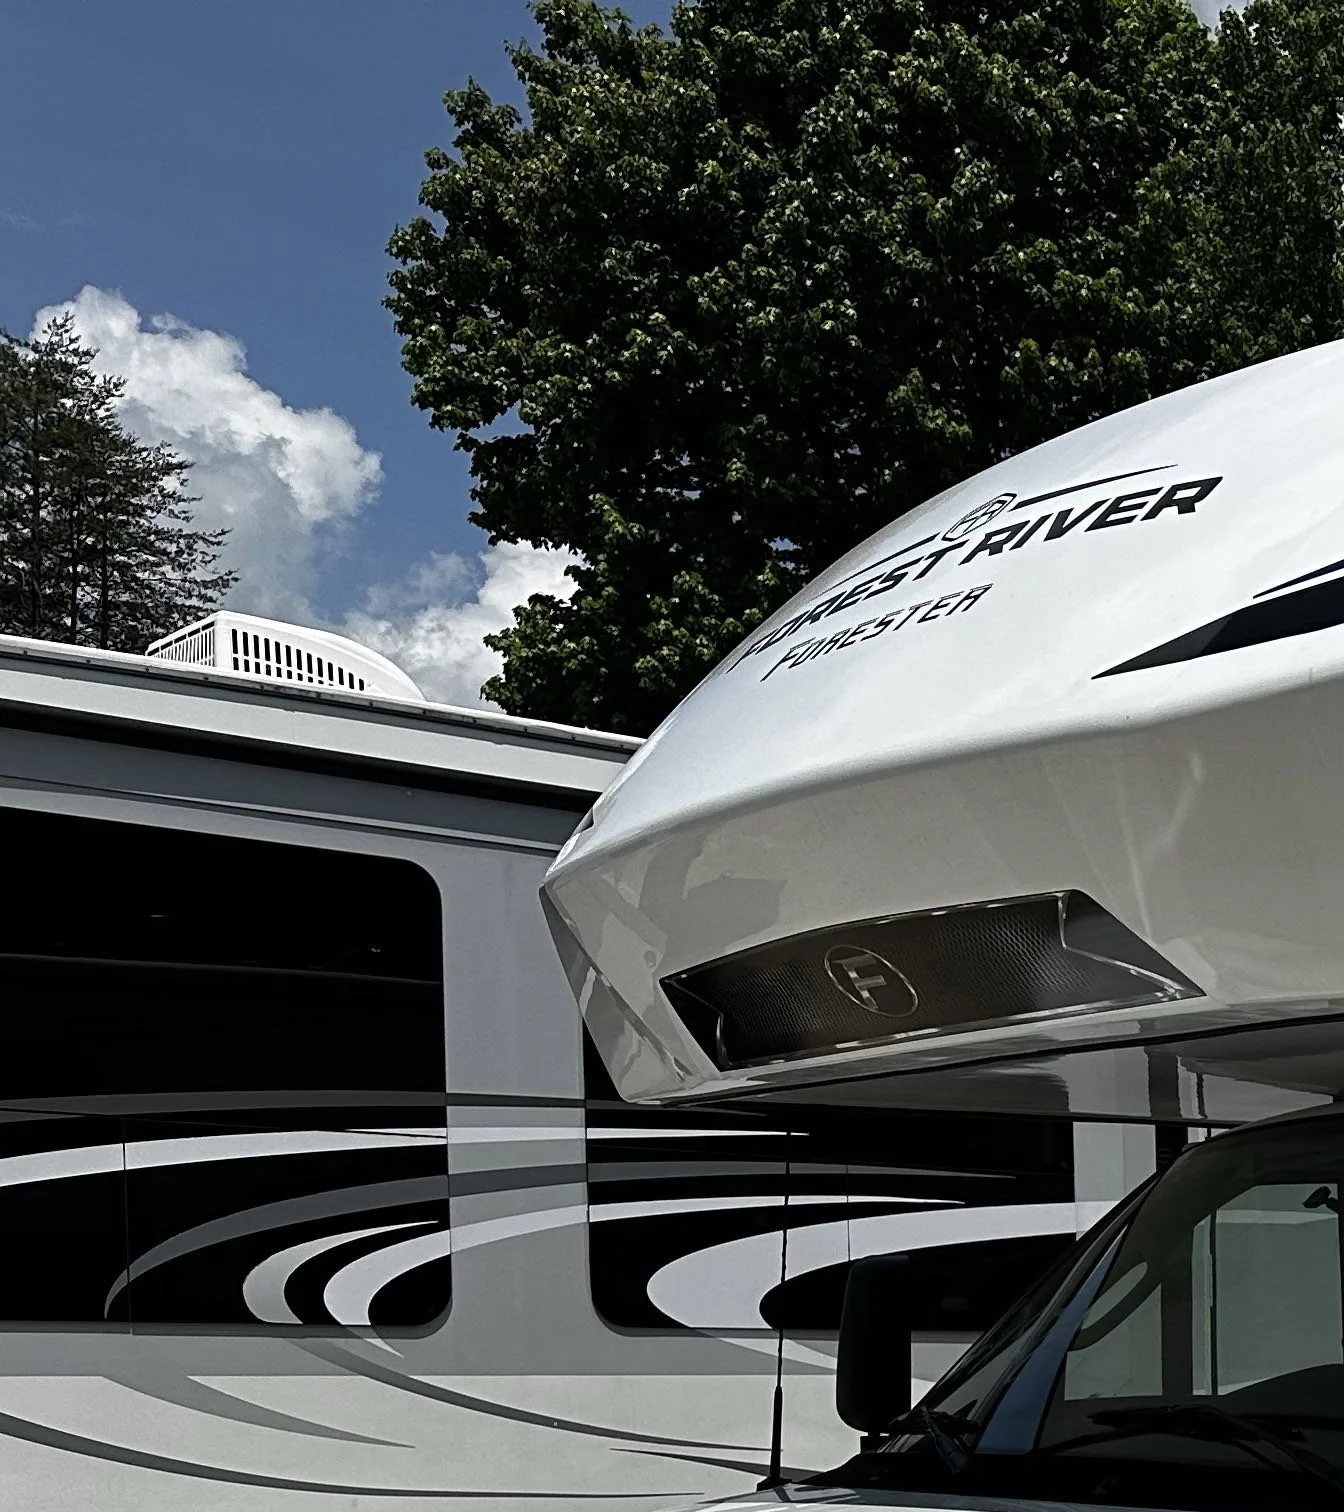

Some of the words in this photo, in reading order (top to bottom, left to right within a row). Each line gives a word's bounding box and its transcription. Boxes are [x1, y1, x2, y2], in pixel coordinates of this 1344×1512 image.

[726, 539, 971, 674] FOREST
[957, 476, 1224, 566] RIVER
[759, 583, 994, 683] FORESTER
